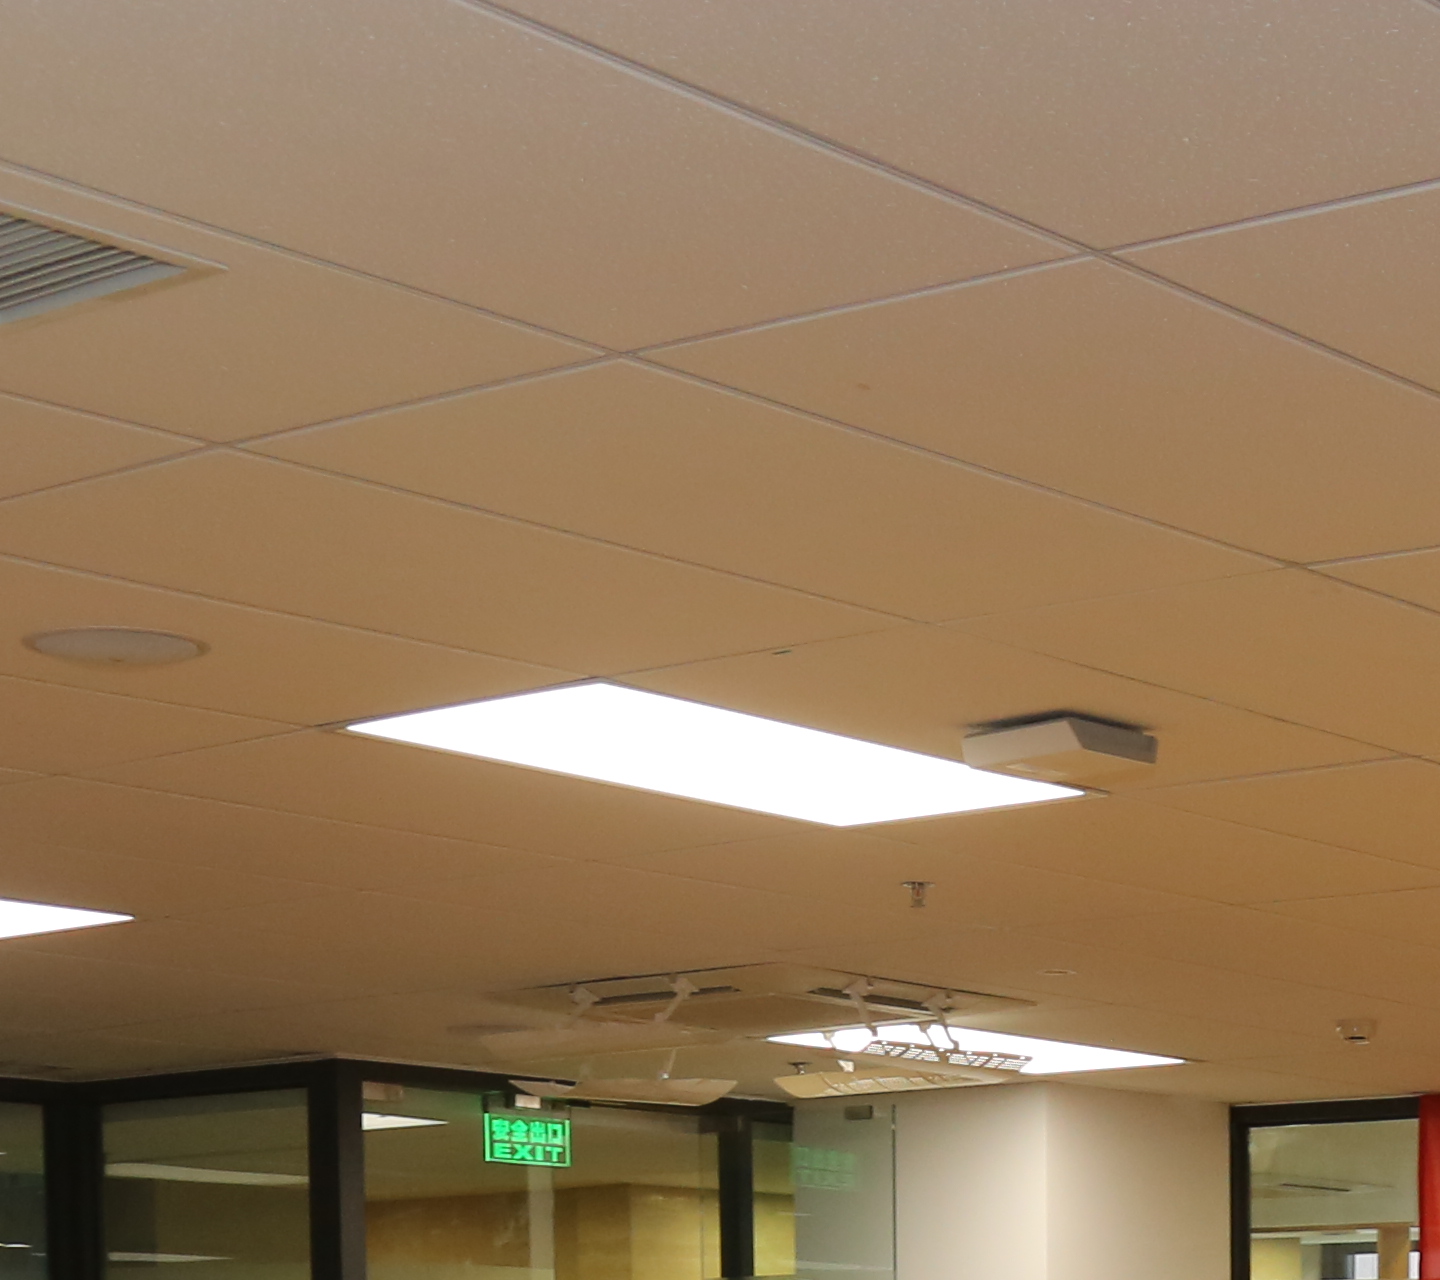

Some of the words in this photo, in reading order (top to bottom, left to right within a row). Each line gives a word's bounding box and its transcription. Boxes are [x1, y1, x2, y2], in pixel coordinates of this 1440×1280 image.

[491, 1118, 564, 1145] 安全出口
[493, 1142, 564, 1162] EXIT
